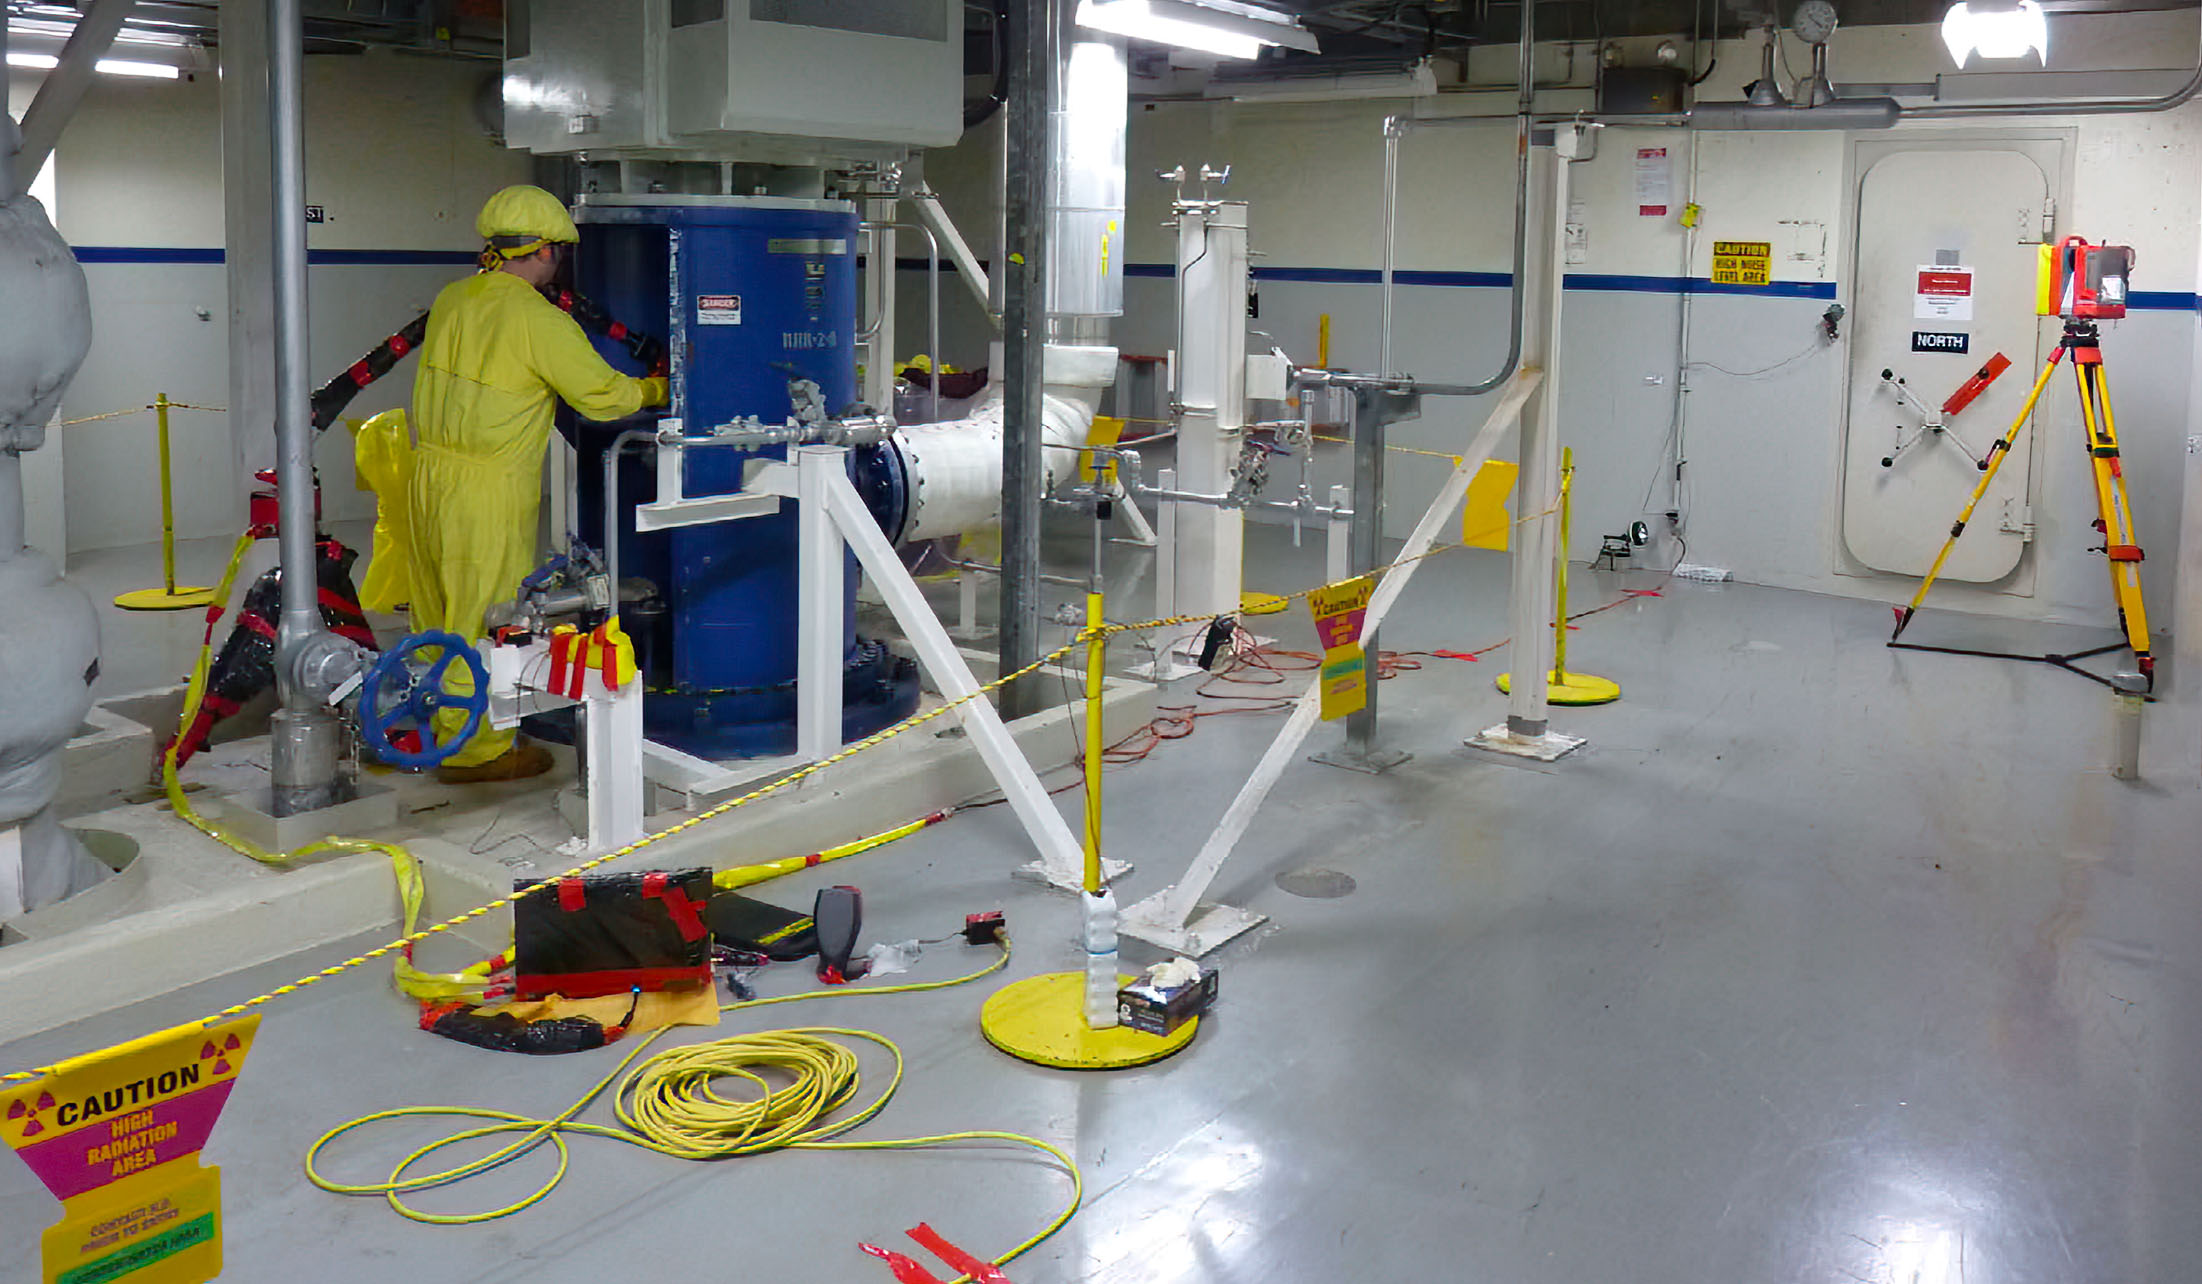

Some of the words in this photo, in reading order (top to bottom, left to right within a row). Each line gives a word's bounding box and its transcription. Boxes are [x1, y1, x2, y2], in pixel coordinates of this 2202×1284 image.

[1917, 334, 1963, 348] NORTH
[57, 1063, 199, 1126] CAUTION
[111, 1109, 153, 1138] HIGH
[88, 1121, 178, 1165] RADIATION
[112, 1149, 157, 1176] AREA
[123, 1223, 139, 1238] TO
